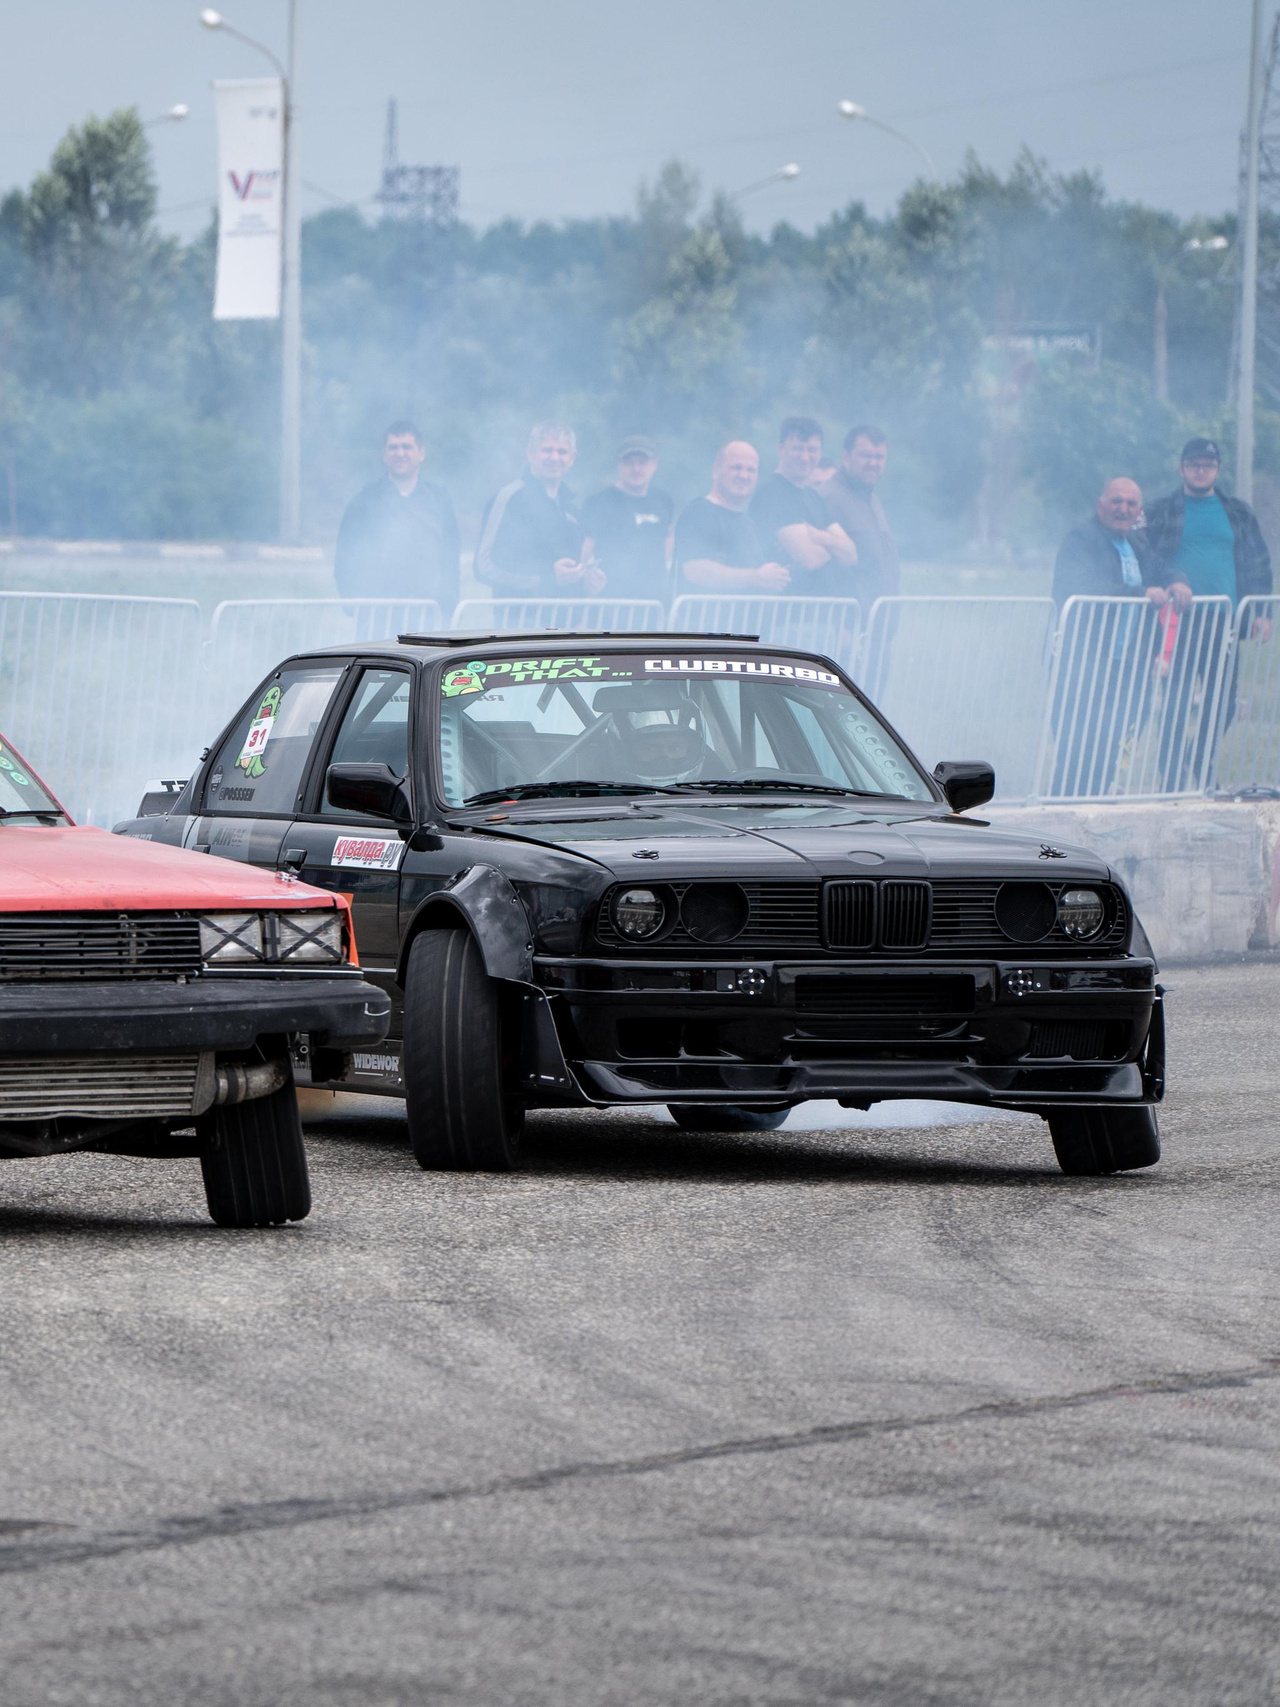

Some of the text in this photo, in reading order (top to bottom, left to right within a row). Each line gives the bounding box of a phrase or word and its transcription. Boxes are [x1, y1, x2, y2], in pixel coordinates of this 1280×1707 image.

[485, 658, 600, 675] DRIFT
[644, 660, 840, 685] CLUBTURBO
[248, 729, 267, 747] 31
[353, 1053, 400, 1071] WIDEWOR
